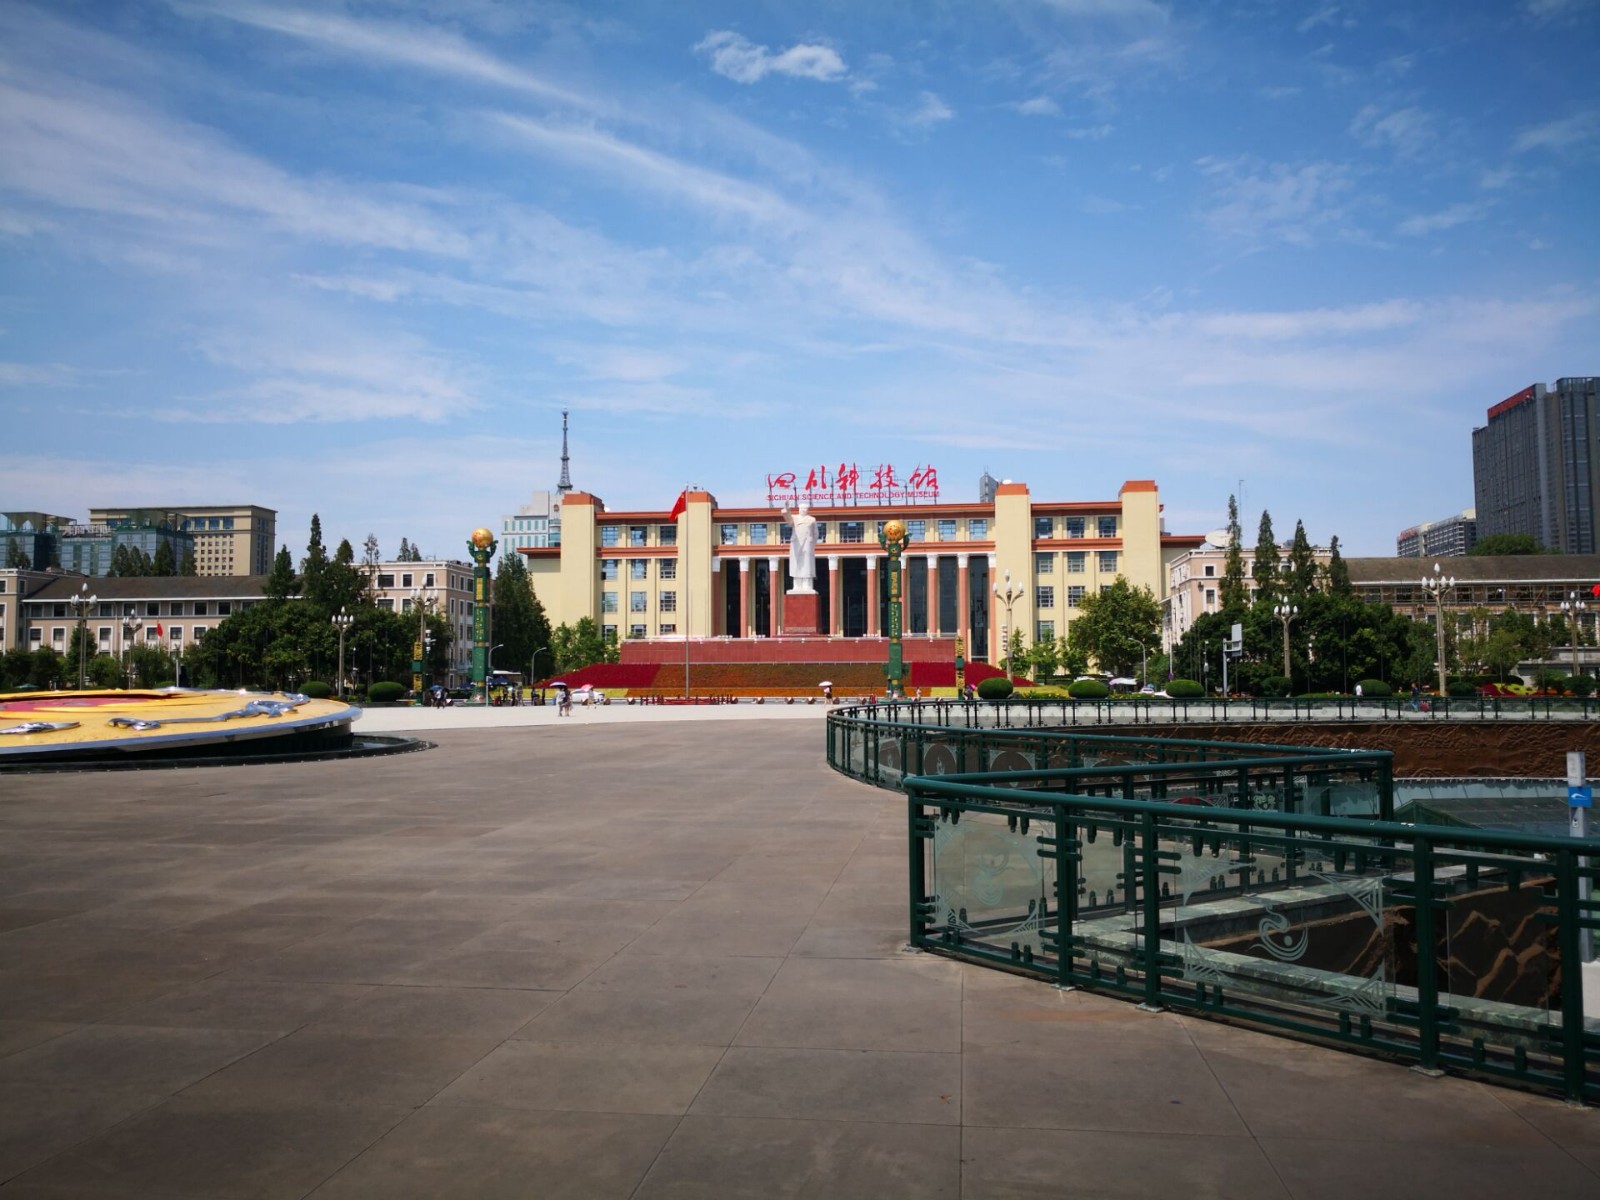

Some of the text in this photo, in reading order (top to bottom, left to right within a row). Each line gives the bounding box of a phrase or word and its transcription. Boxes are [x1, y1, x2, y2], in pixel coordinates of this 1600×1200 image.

[767, 462, 939, 490] 四川科技馆
[802, 493, 834, 501] SCIENCE
[856, 491, 905, 499] TECHNOLOGY
